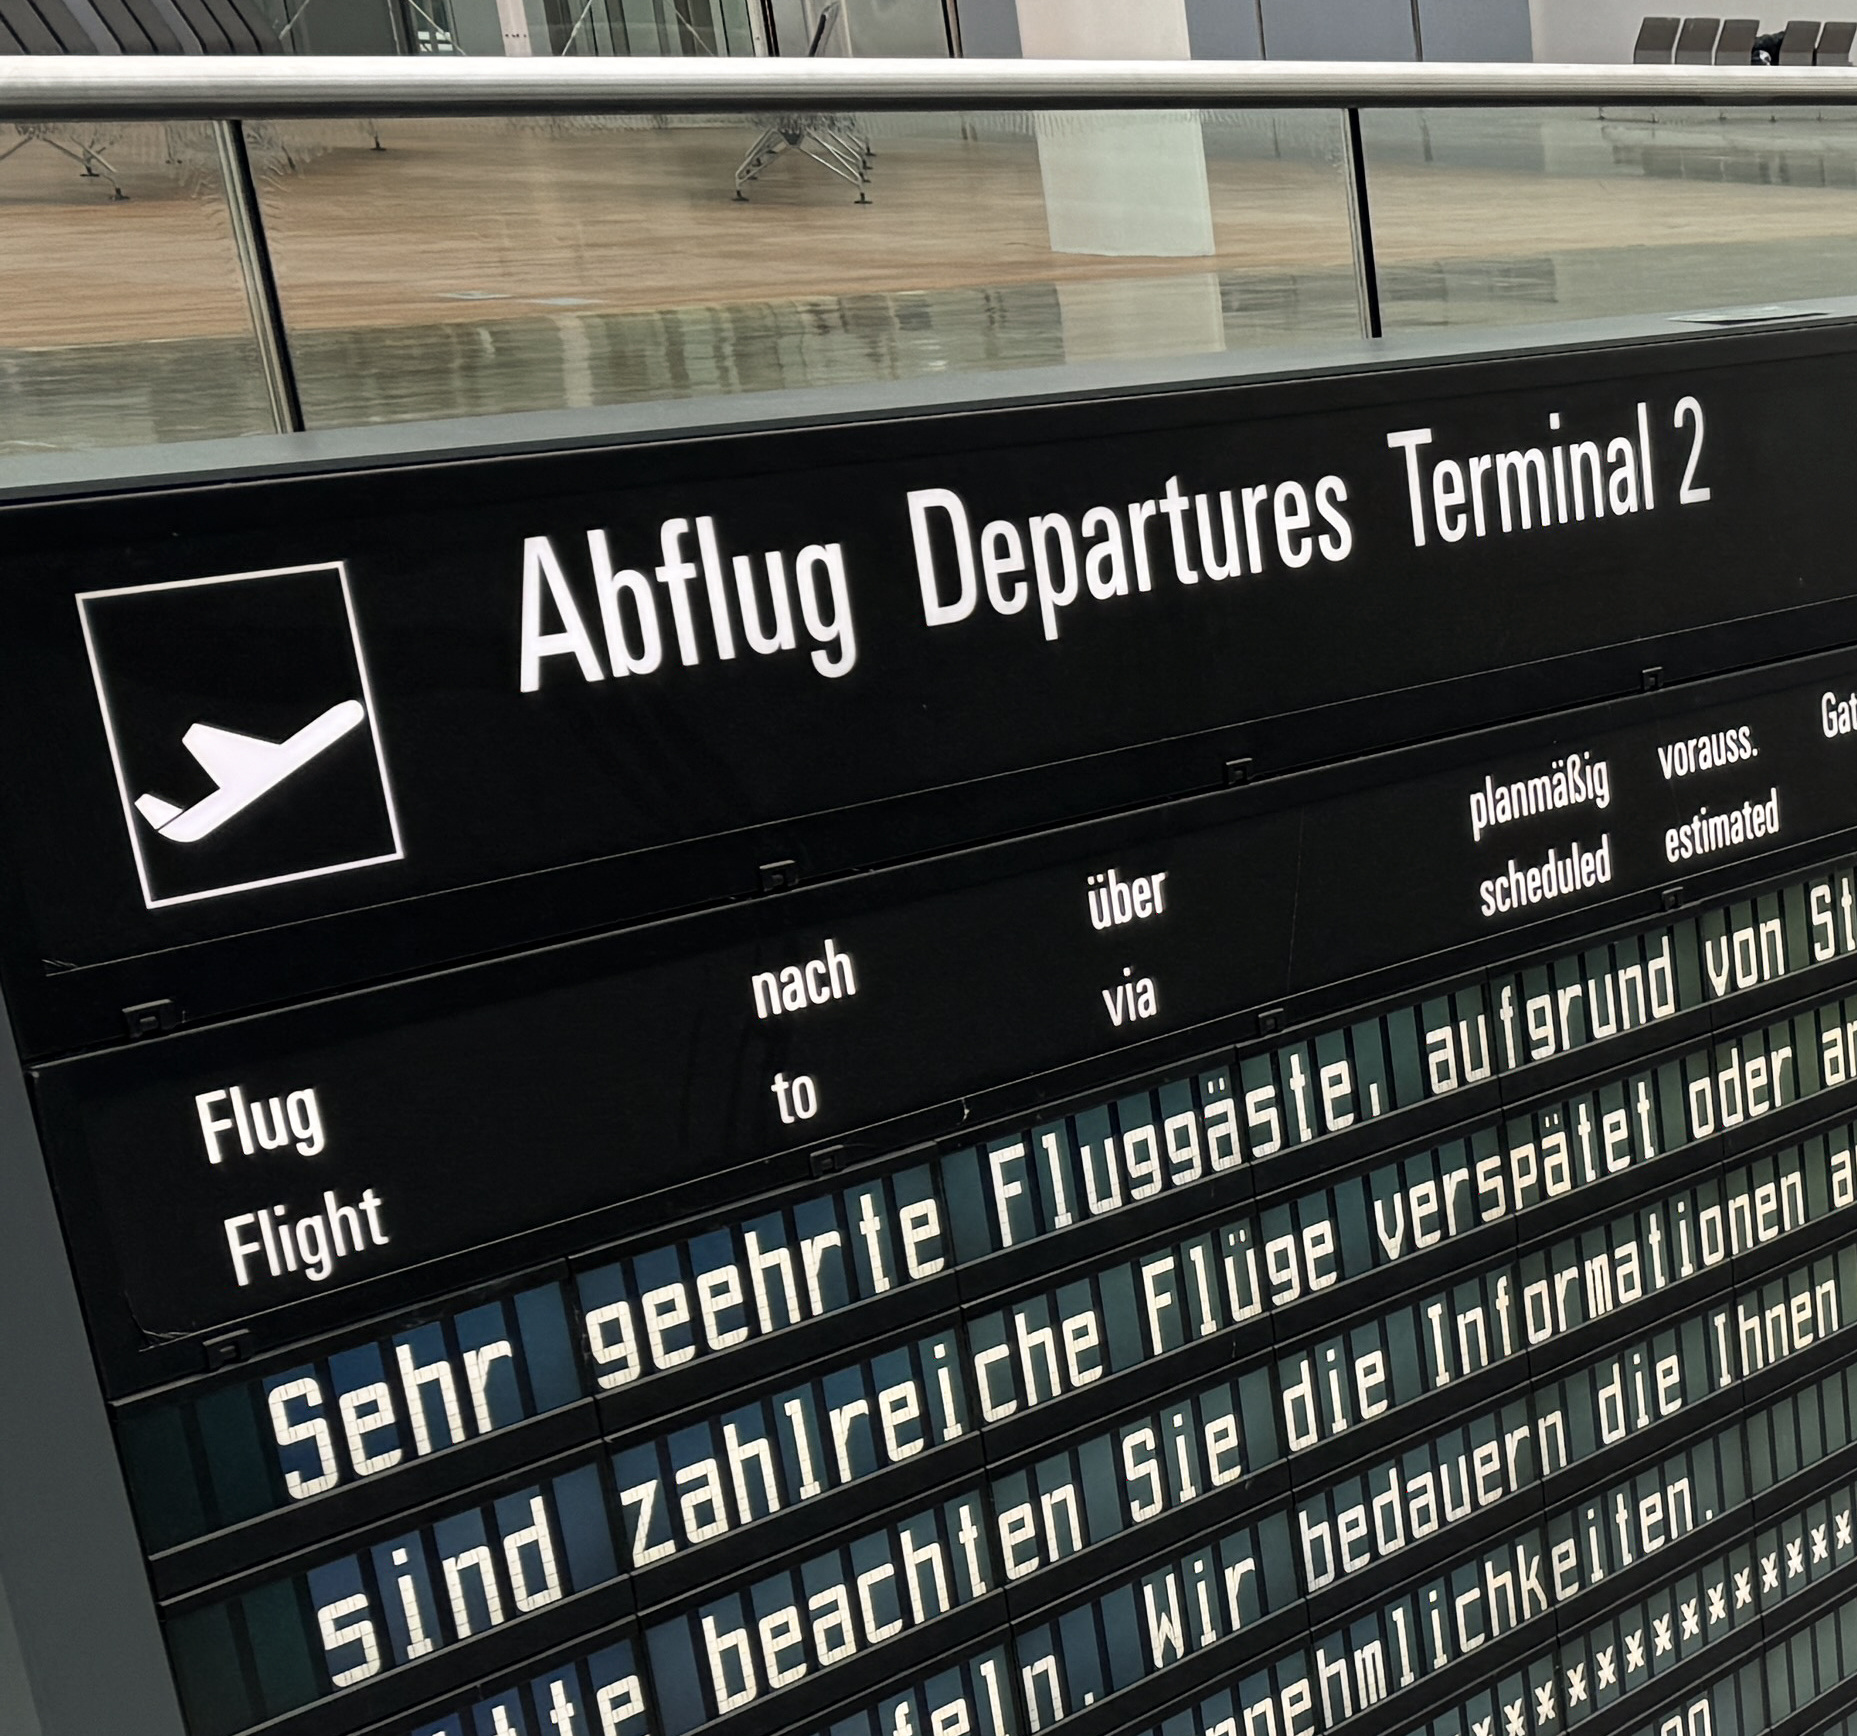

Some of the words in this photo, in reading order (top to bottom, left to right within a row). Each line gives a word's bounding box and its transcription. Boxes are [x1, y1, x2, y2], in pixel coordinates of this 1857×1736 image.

[521, 516, 856, 692] Abflug
[907, 476, 1352, 640] Departures
[1387, 403, 1654, 546] Terminal
[1674, 396, 1710, 504] 2
[1657, 726, 1757, 779] vorauss.
[1470, 754, 1609, 841] planmäßig
[1665, 787, 1778, 862] estimated
[1088, 869, 1165, 929] über
[1480, 833, 1610, 916] scheduled
[751, 939, 855, 1018] nach
[1102, 978, 1156, 1025] via
[195, 1086, 324, 1163] Flug
[771, 1072, 816, 1123] to
[224, 1188, 388, 1285] Flight
[268, 1340, 511, 1498] Sehr
[585, 1194, 943, 1388] geehrte
[989, 1053, 1380, 1246] Fluggäste,
[1426, 936, 1674, 1093] aufgrund
[1705, 918, 1784, 996] von
[317, 1496, 561, 1686] sind
[620, 1310, 1102, 1566] zahlreiche
[1141, 1220, 1336, 1355] Flüge
[1374, 1081, 1654, 1259] verspätet
[1688, 1046, 1792, 1138] oder
[701, 1484, 1081, 1714] beachten
[1122, 1413, 1240, 1522] Sie
[1283, 1349, 1387, 1451] die
[1427, 1171, 1804, 1386] Informationen
[1143, 1557, 1254, 1668] Wir
[1299, 1410, 1566, 1591] bedauern
[1598, 1353, 1681, 1444] die
[1713, 1279, 1838, 1386] Ihnen
